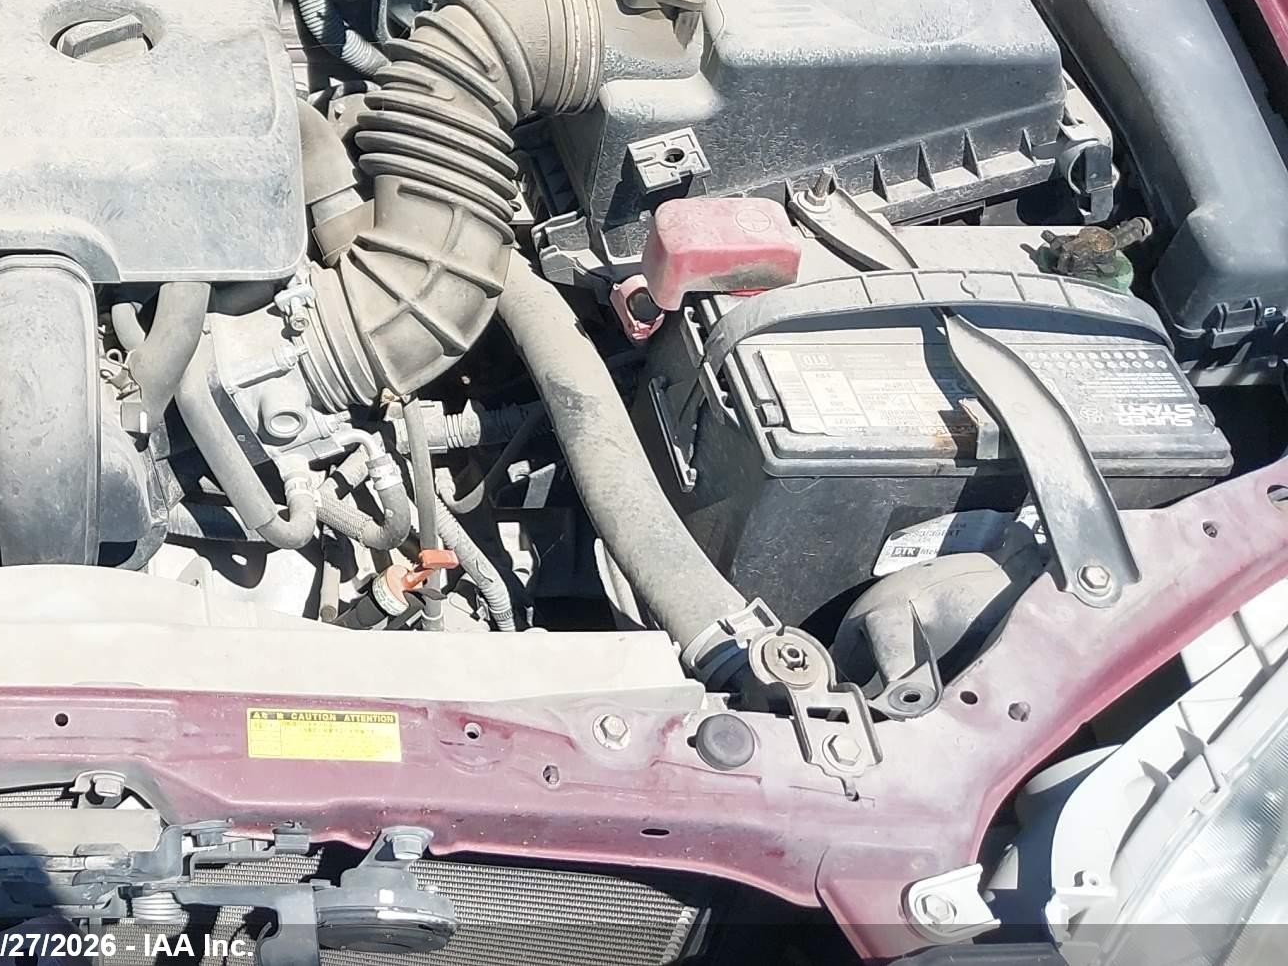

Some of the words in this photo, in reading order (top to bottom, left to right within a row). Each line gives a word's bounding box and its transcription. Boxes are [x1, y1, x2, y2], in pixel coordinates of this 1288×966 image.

[1114, 403, 1196, 417] START
[1118, 416, 1193, 427] SUPER
[290, 712, 337, 722] CAUTION
[343, 713, 394, 723] ATTENTION
